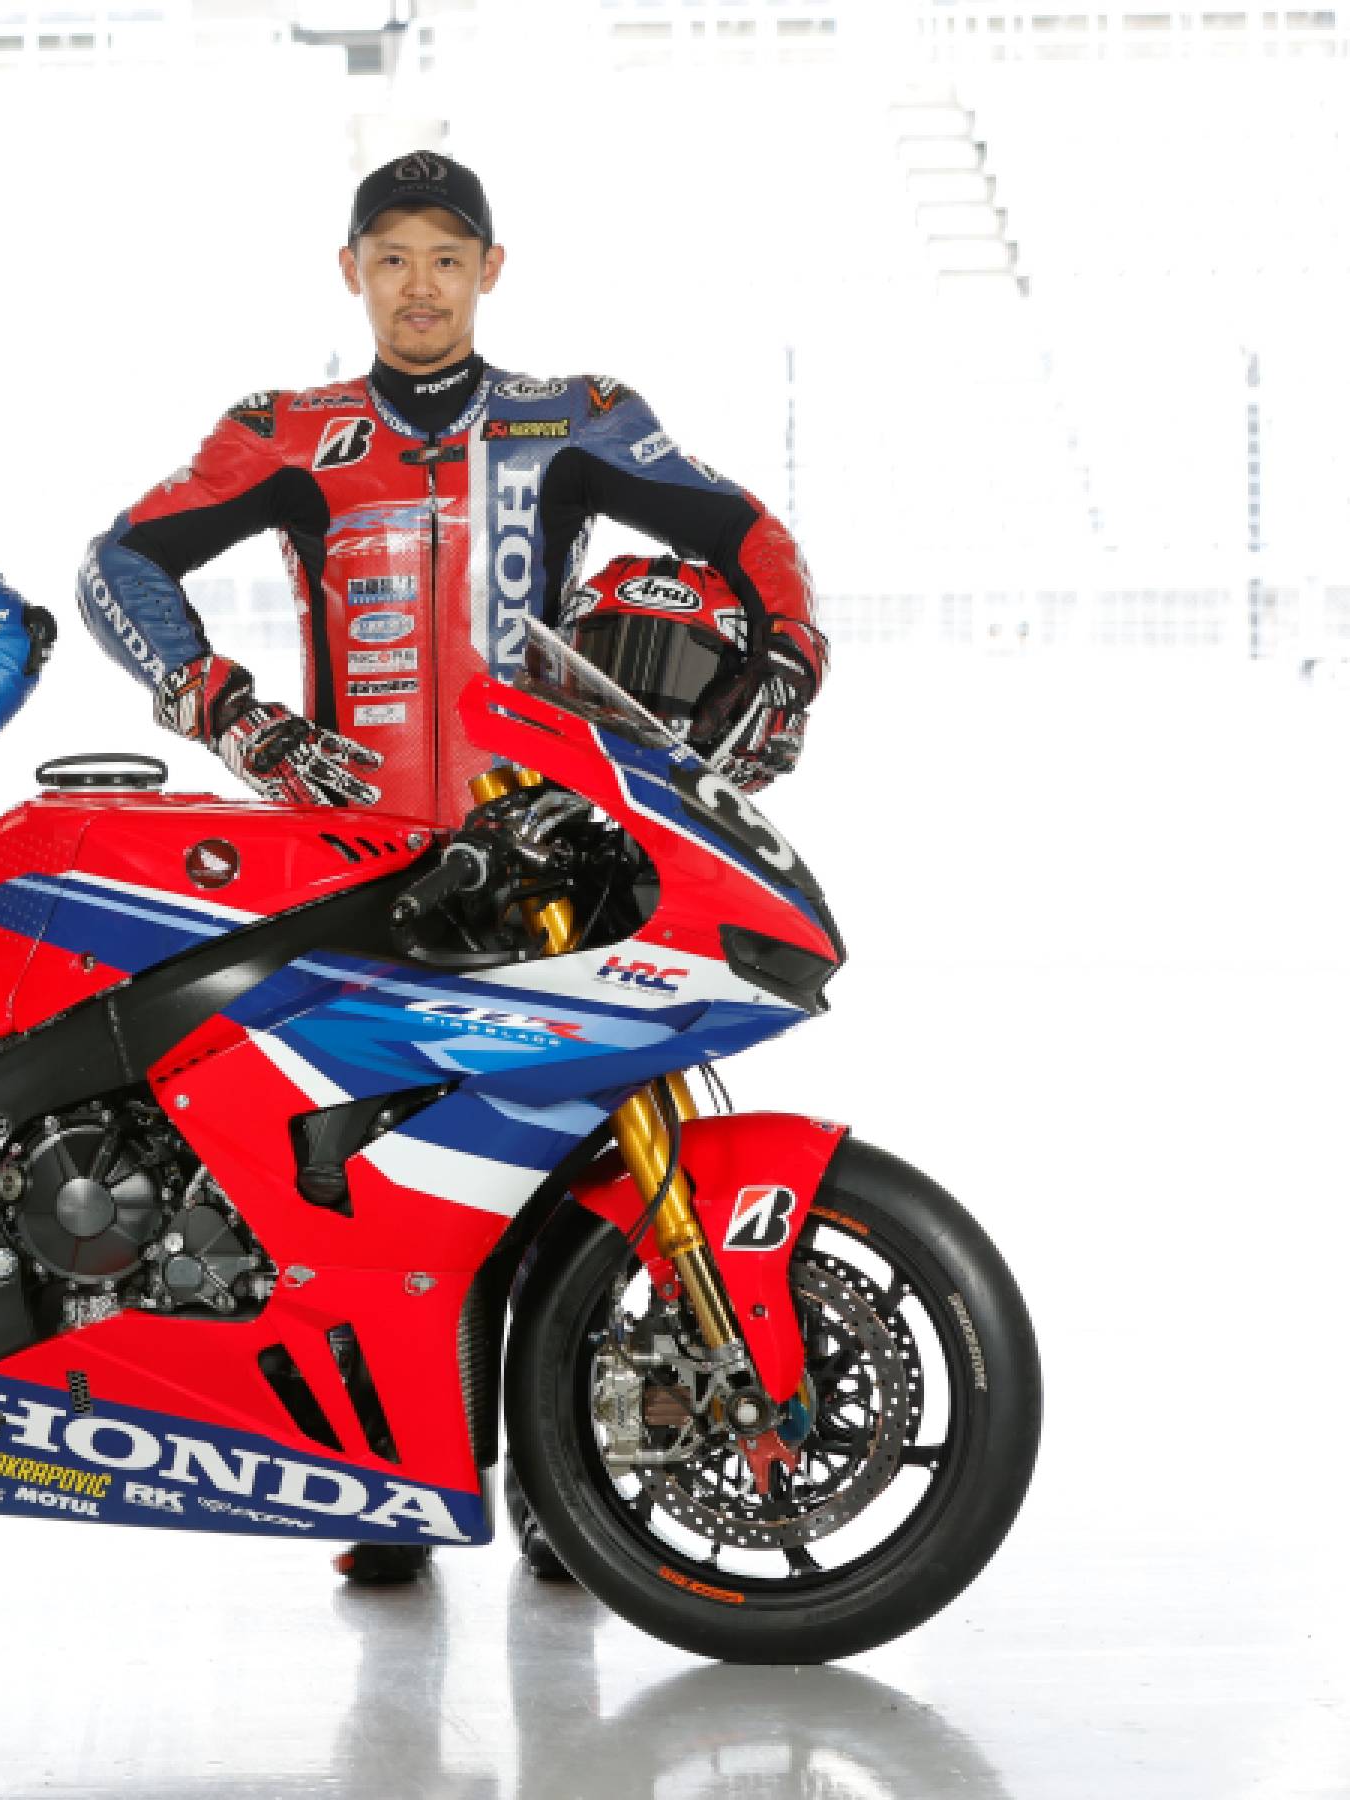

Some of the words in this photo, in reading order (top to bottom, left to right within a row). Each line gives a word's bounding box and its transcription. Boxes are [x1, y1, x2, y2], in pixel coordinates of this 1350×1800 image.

[495, 461, 541, 687] HON
[696, 773, 794, 871] 3
[597, 955, 690, 991] HRC
[404, 999, 592, 1044] CBR
[423, 1015, 561, 1047] FIREBLADE
[14, 1486, 101, 1518] MOTUL
[124, 1481, 186, 1514] RK
